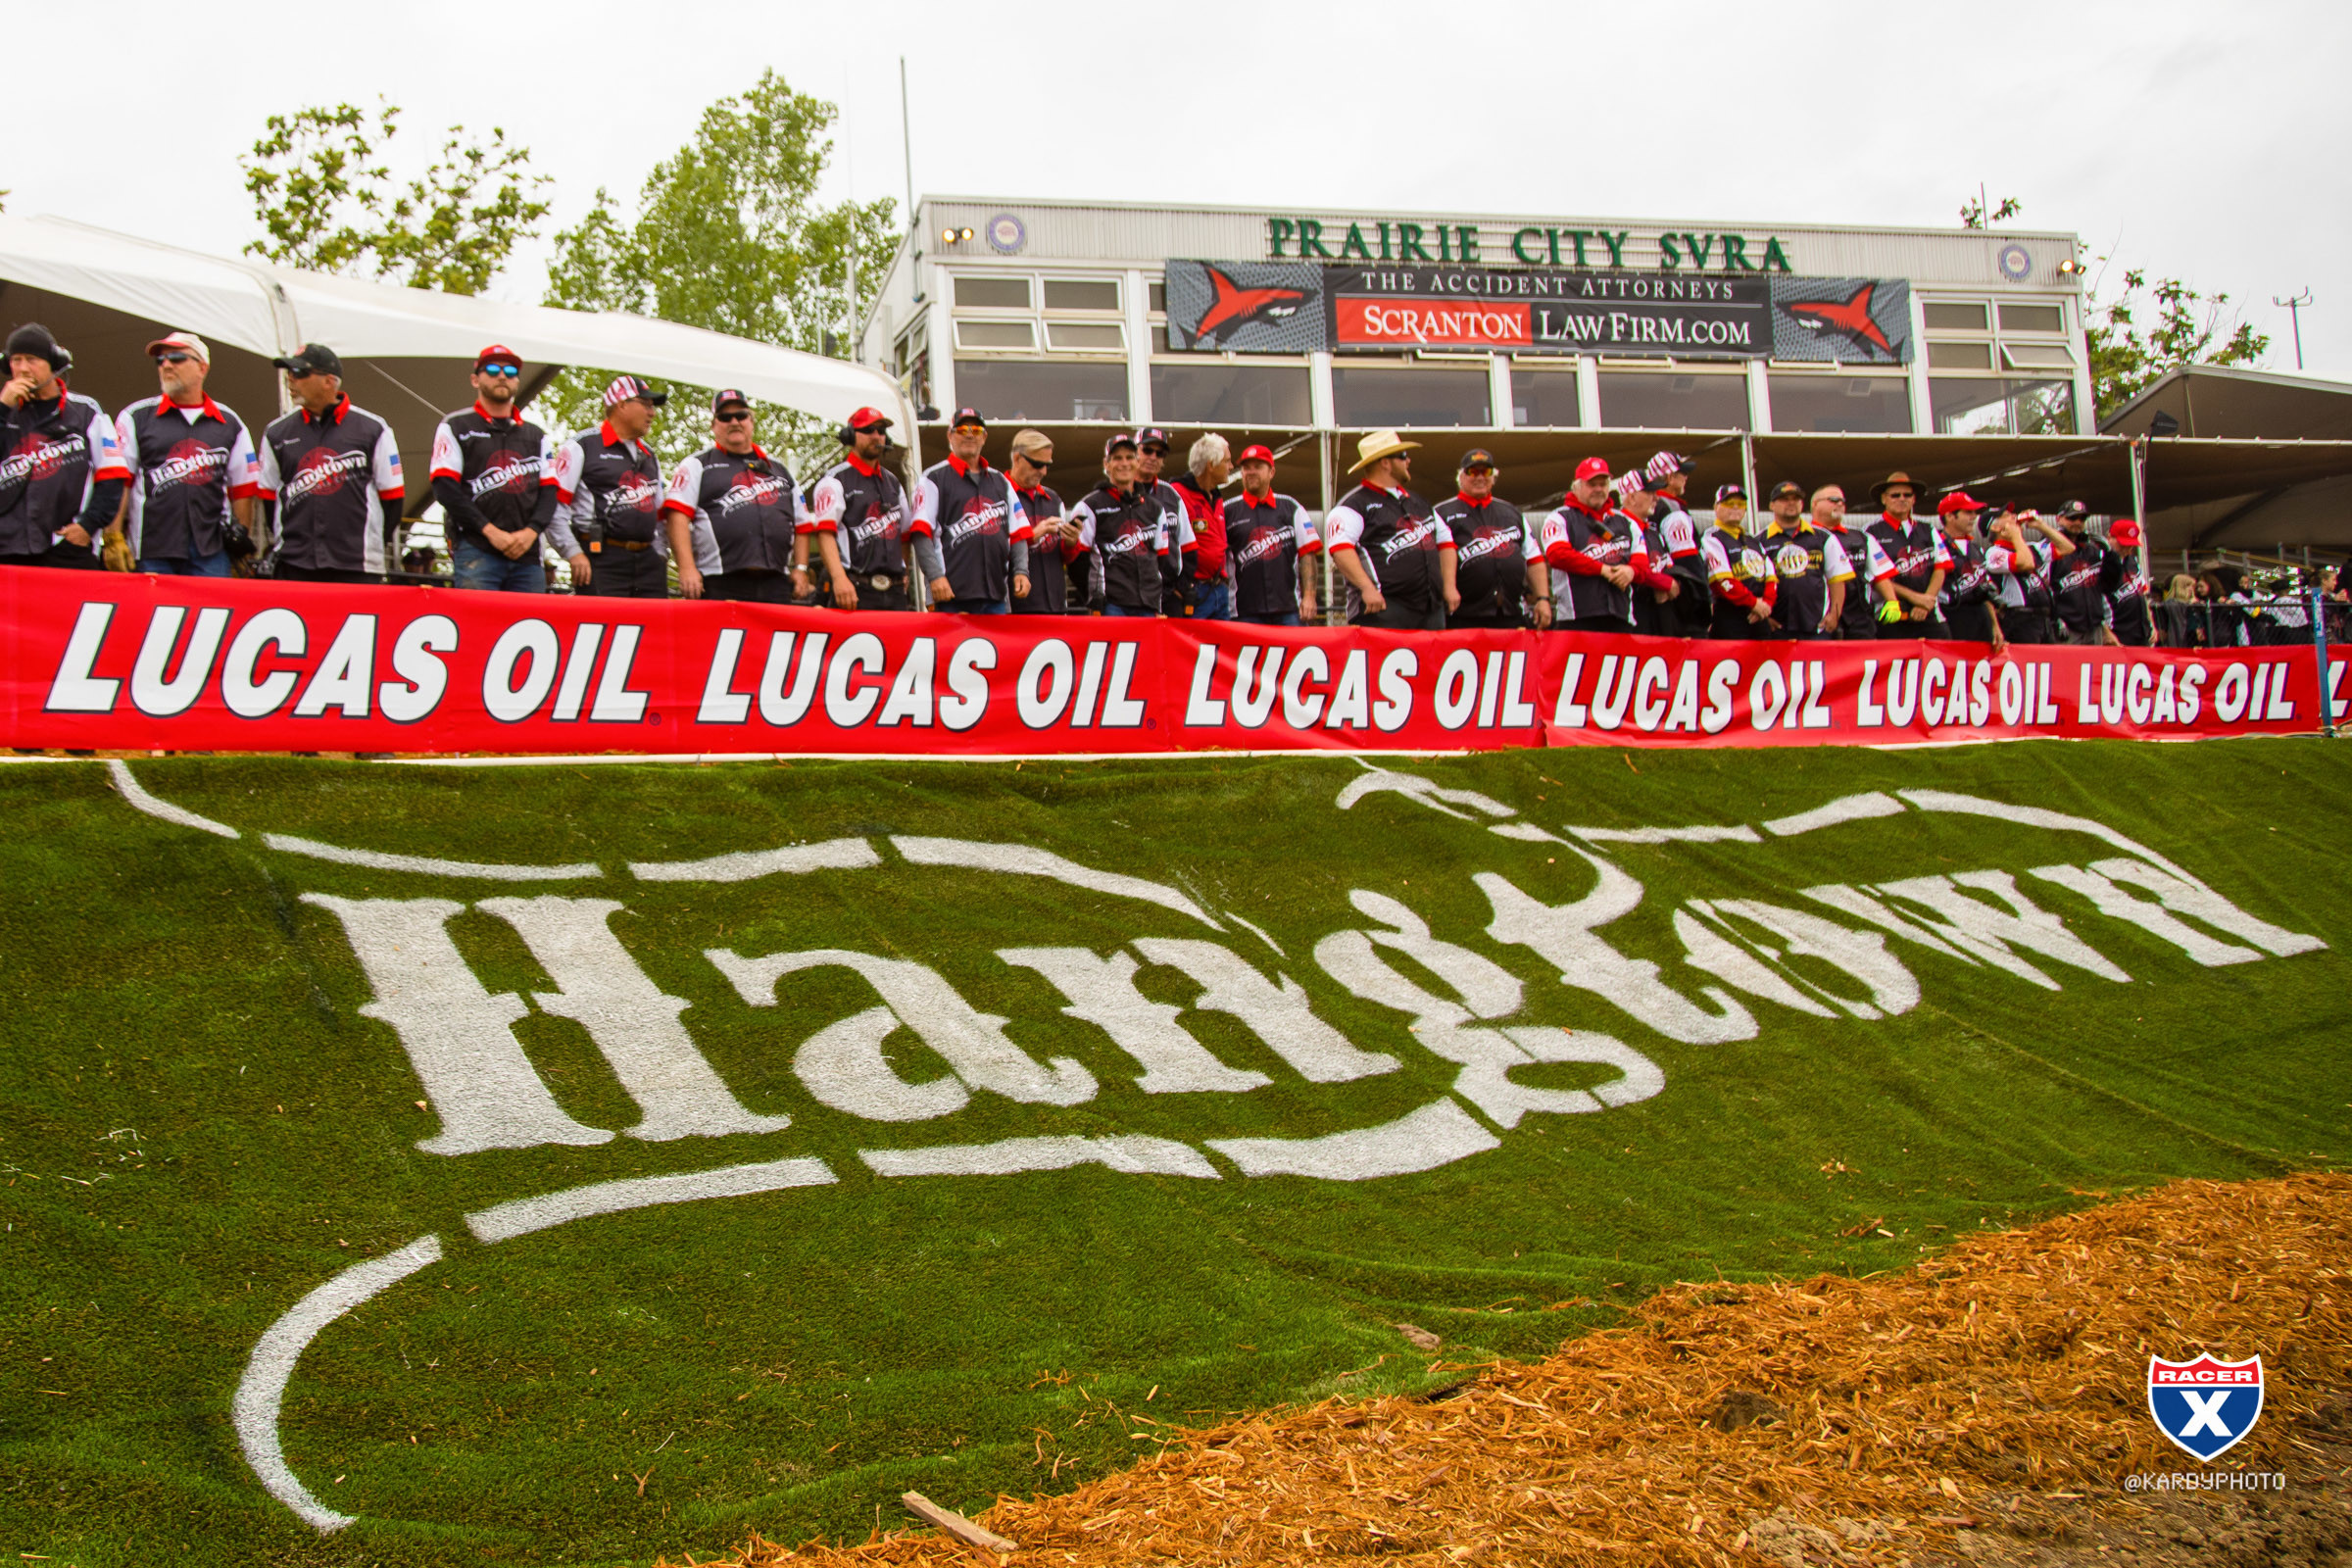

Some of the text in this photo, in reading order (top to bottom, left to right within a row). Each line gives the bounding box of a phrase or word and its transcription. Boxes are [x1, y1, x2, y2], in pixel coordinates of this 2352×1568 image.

[1269, 219, 1791, 271] PRAIRIE CITY SVRA
[1362, 271, 1733, 299] THE ACCIDENT ATTORNEYS
[149, 448, 228, 484] Hangtown
[285, 454, 368, 498] Hangtown
[1237, 527, 1295, 564] Hangtown
[43, 601, 652, 725] LUCAS OIL
[695, 628, 1147, 731] LUCAS OIL
[1184, 644, 1536, 733] LUCAS OIL
[1554, 653, 1832, 734] LUCAS OIL
[1857, 658, 2059, 727] LUCAS OIL
[2079, 662, 2295, 725] LUCAS OIL
[299, 828, 2328, 1156] Hangtown
